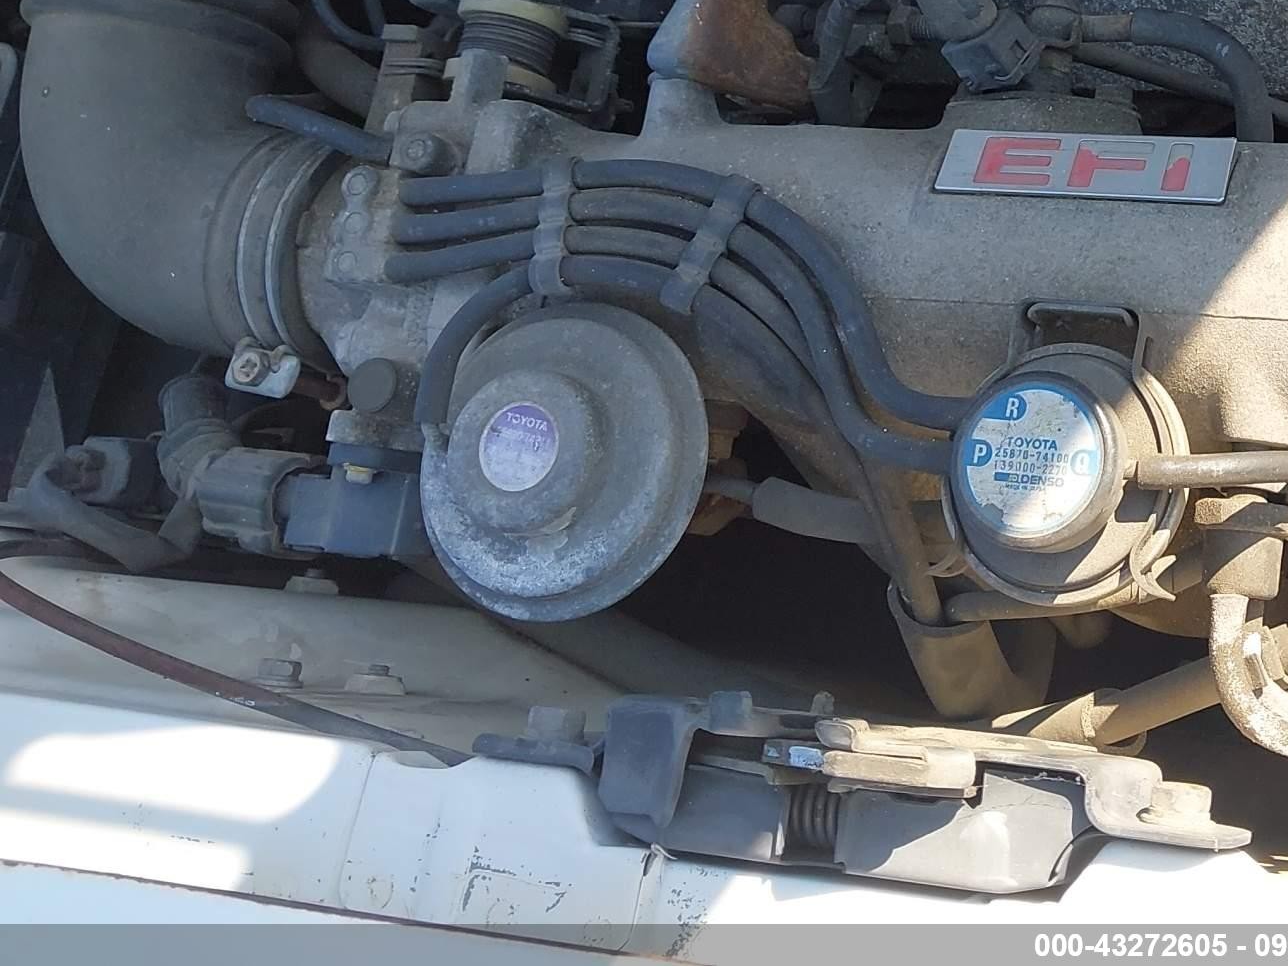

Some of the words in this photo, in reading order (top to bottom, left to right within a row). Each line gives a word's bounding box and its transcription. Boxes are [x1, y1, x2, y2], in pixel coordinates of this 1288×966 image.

[973, 135, 1195, 192] EFI
[1005, 397, 1019, 419] R
[506, 412, 548, 431] TOYOTA
[1007, 437, 1058, 450] TOYOTA
[973, 444, 988, 464] P
[1021, 474, 1065, 488] DENSO
